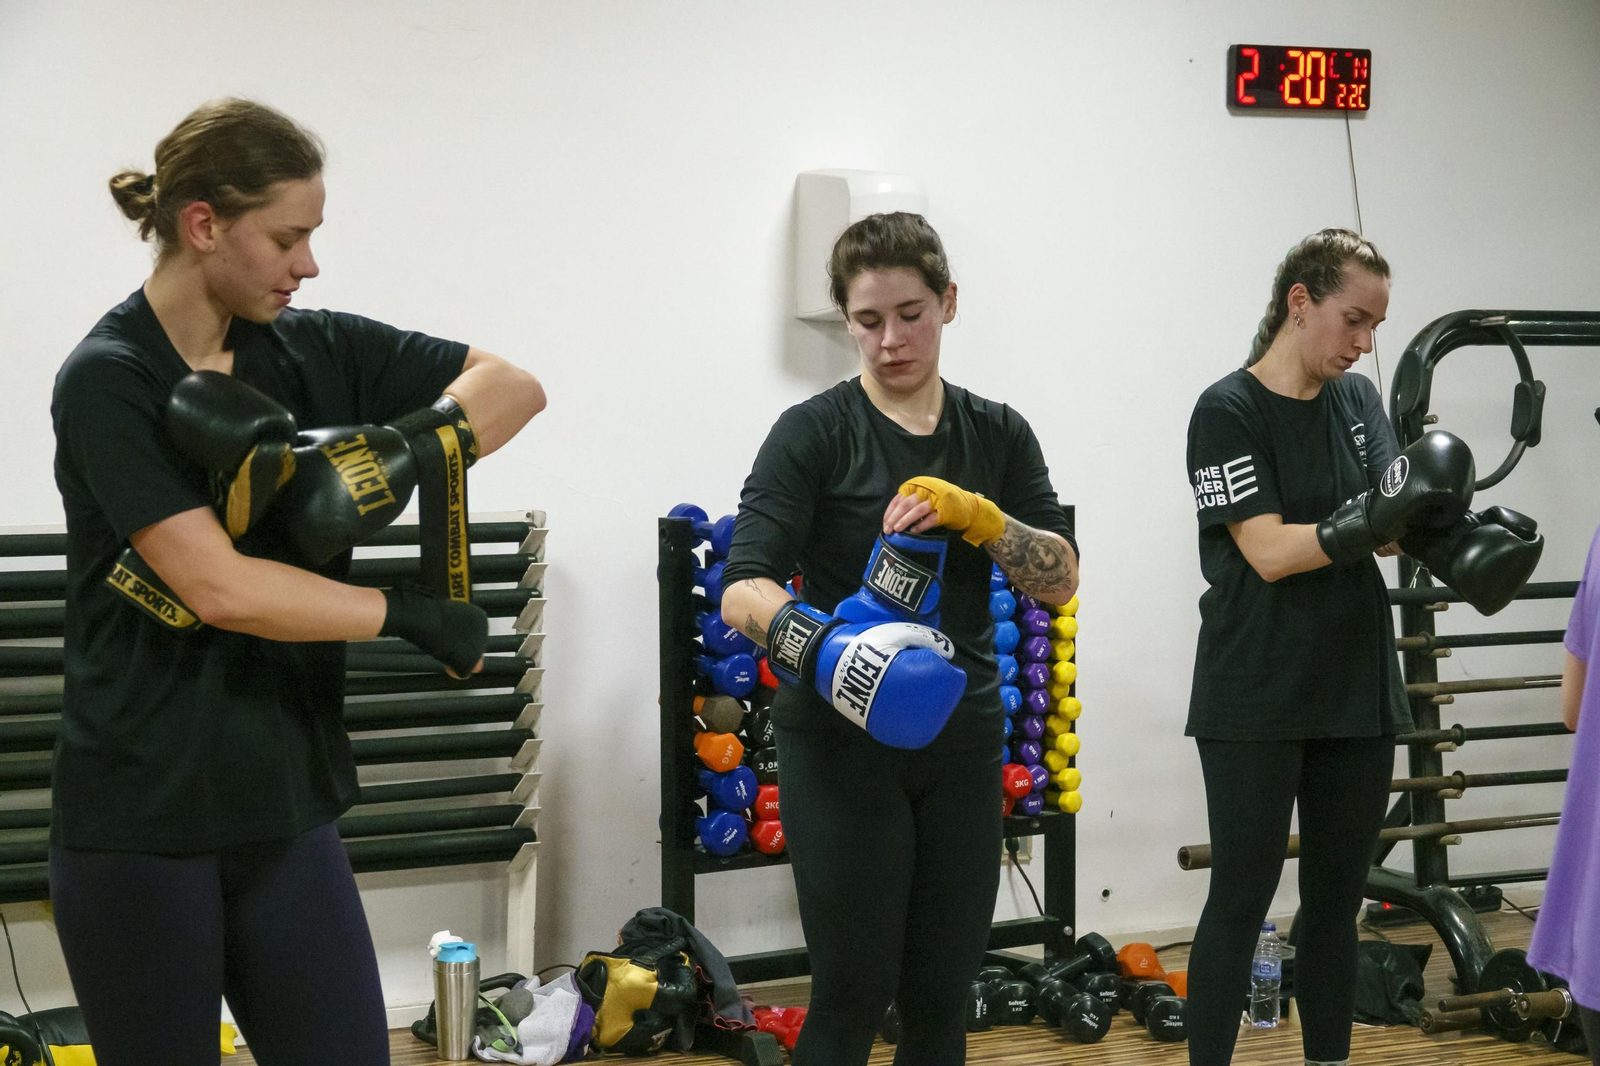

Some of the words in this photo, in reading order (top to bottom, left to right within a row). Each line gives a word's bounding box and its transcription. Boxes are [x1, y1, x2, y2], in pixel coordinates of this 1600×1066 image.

[320, 433, 397, 516] LEONE
[447, 448, 461, 506] SPORTS.
[1195, 466, 1222, 482] THE
[1195, 480, 1225, 498] XER
[1197, 494, 1228, 511] LUB
[449, 509, 463, 568] COMBAT
[451, 571, 464, 600] ARE
[874, 558, 920, 603] LEONE
[128, 580, 178, 623] SPORTS.
[776, 619, 812, 669] LEONE
[836, 642, 891, 718] LEONE
[838, 655, 852, 682] 1947
[722, 744, 734, 764] 4KG
[1015, 779, 1029, 788] 3KG
[770, 830, 783, 848] 3KG
